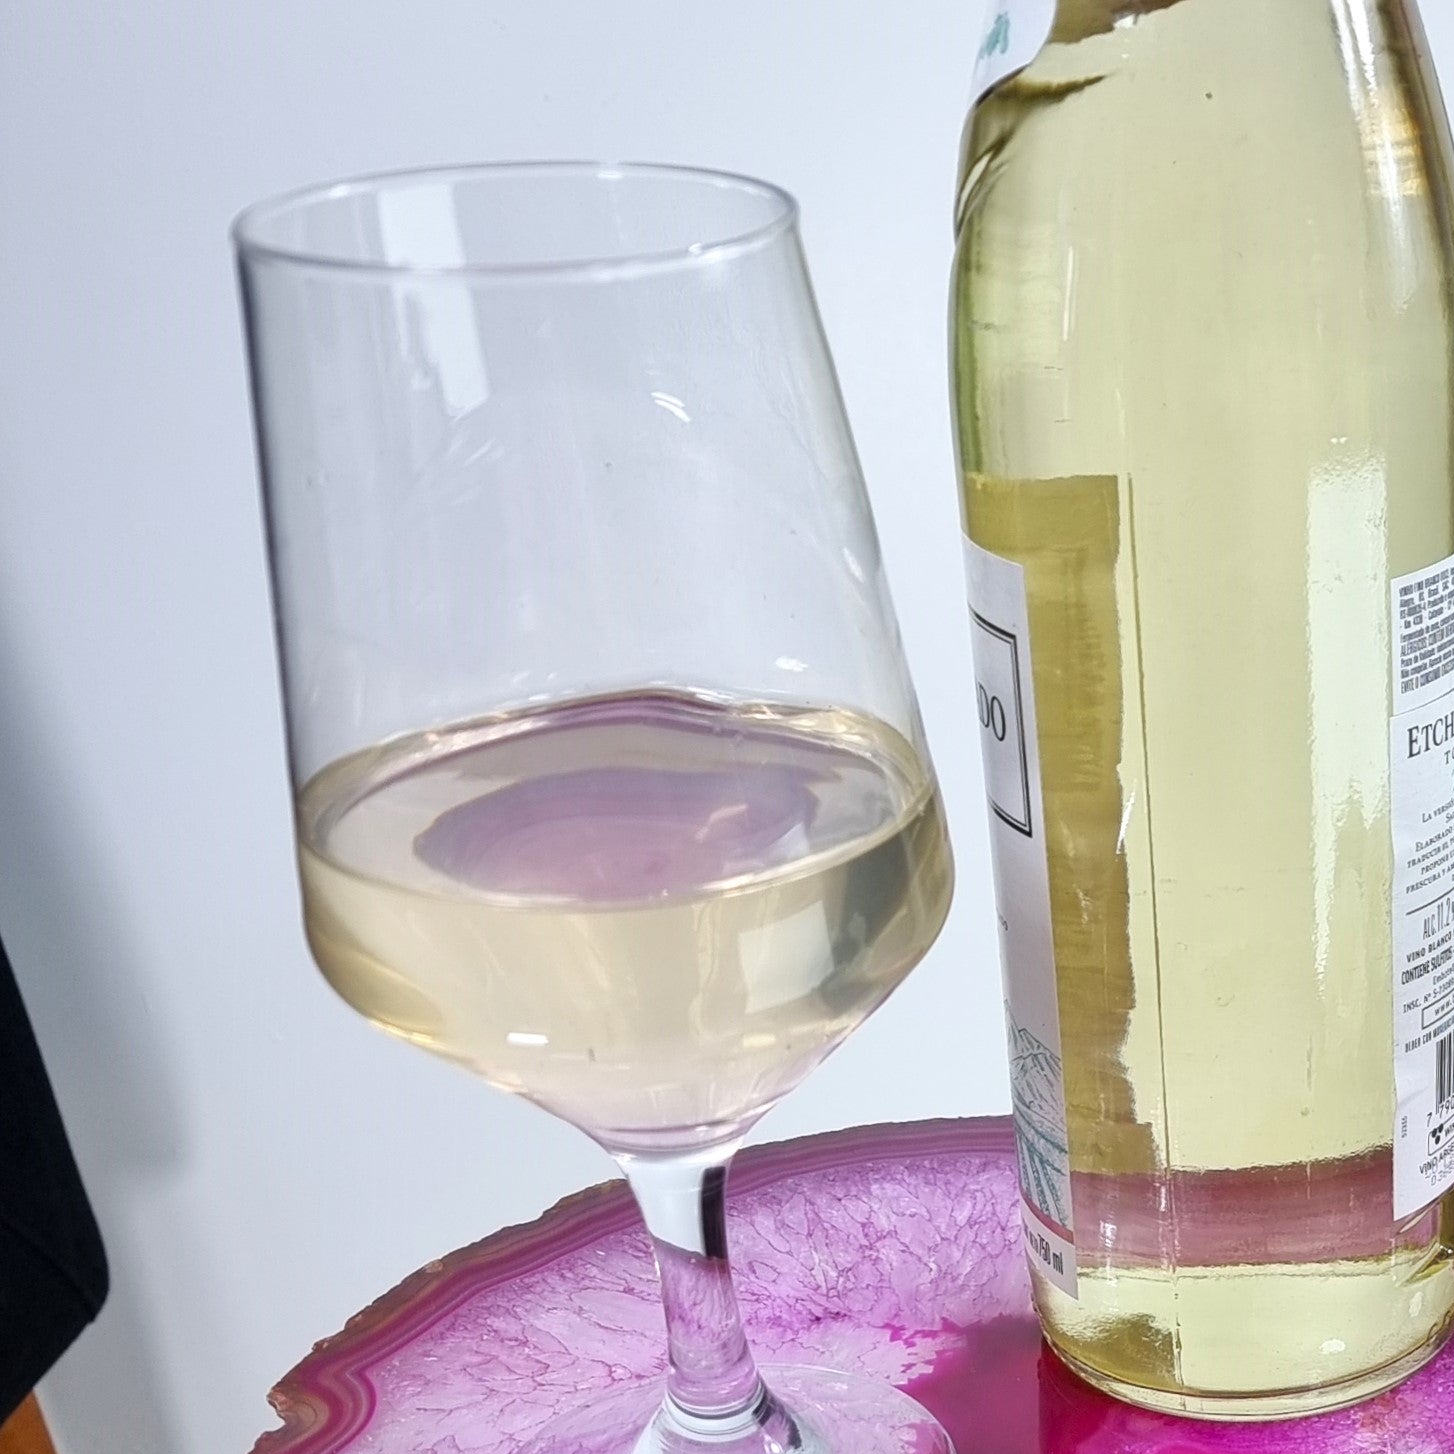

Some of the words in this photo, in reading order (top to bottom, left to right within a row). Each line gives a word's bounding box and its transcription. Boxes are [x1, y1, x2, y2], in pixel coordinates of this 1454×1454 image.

[1406, 947, 1426, 963] VINO
[1428, 933, 1451, 952] BLANCO
[1401, 959, 1430, 985] CONTIENE
